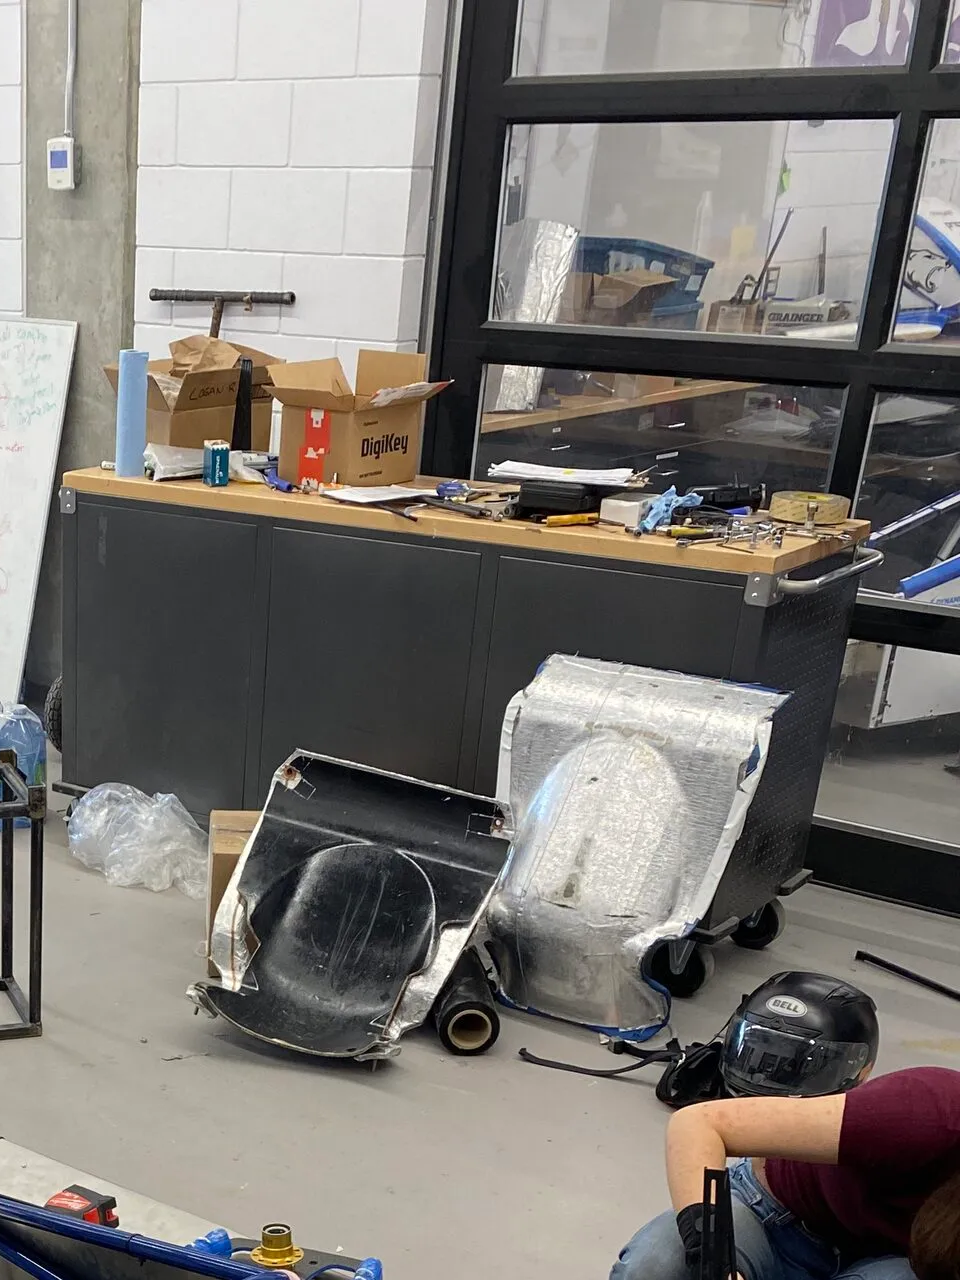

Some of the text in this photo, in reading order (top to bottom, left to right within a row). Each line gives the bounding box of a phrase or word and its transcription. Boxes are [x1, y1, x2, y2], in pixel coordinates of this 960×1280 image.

[768, 312, 824, 323] GRAINGER
[189, 387, 224, 401] LOGAN
[360, 432, 409, 460] DigiKey
[772, 999, 799, 1013] BELL
